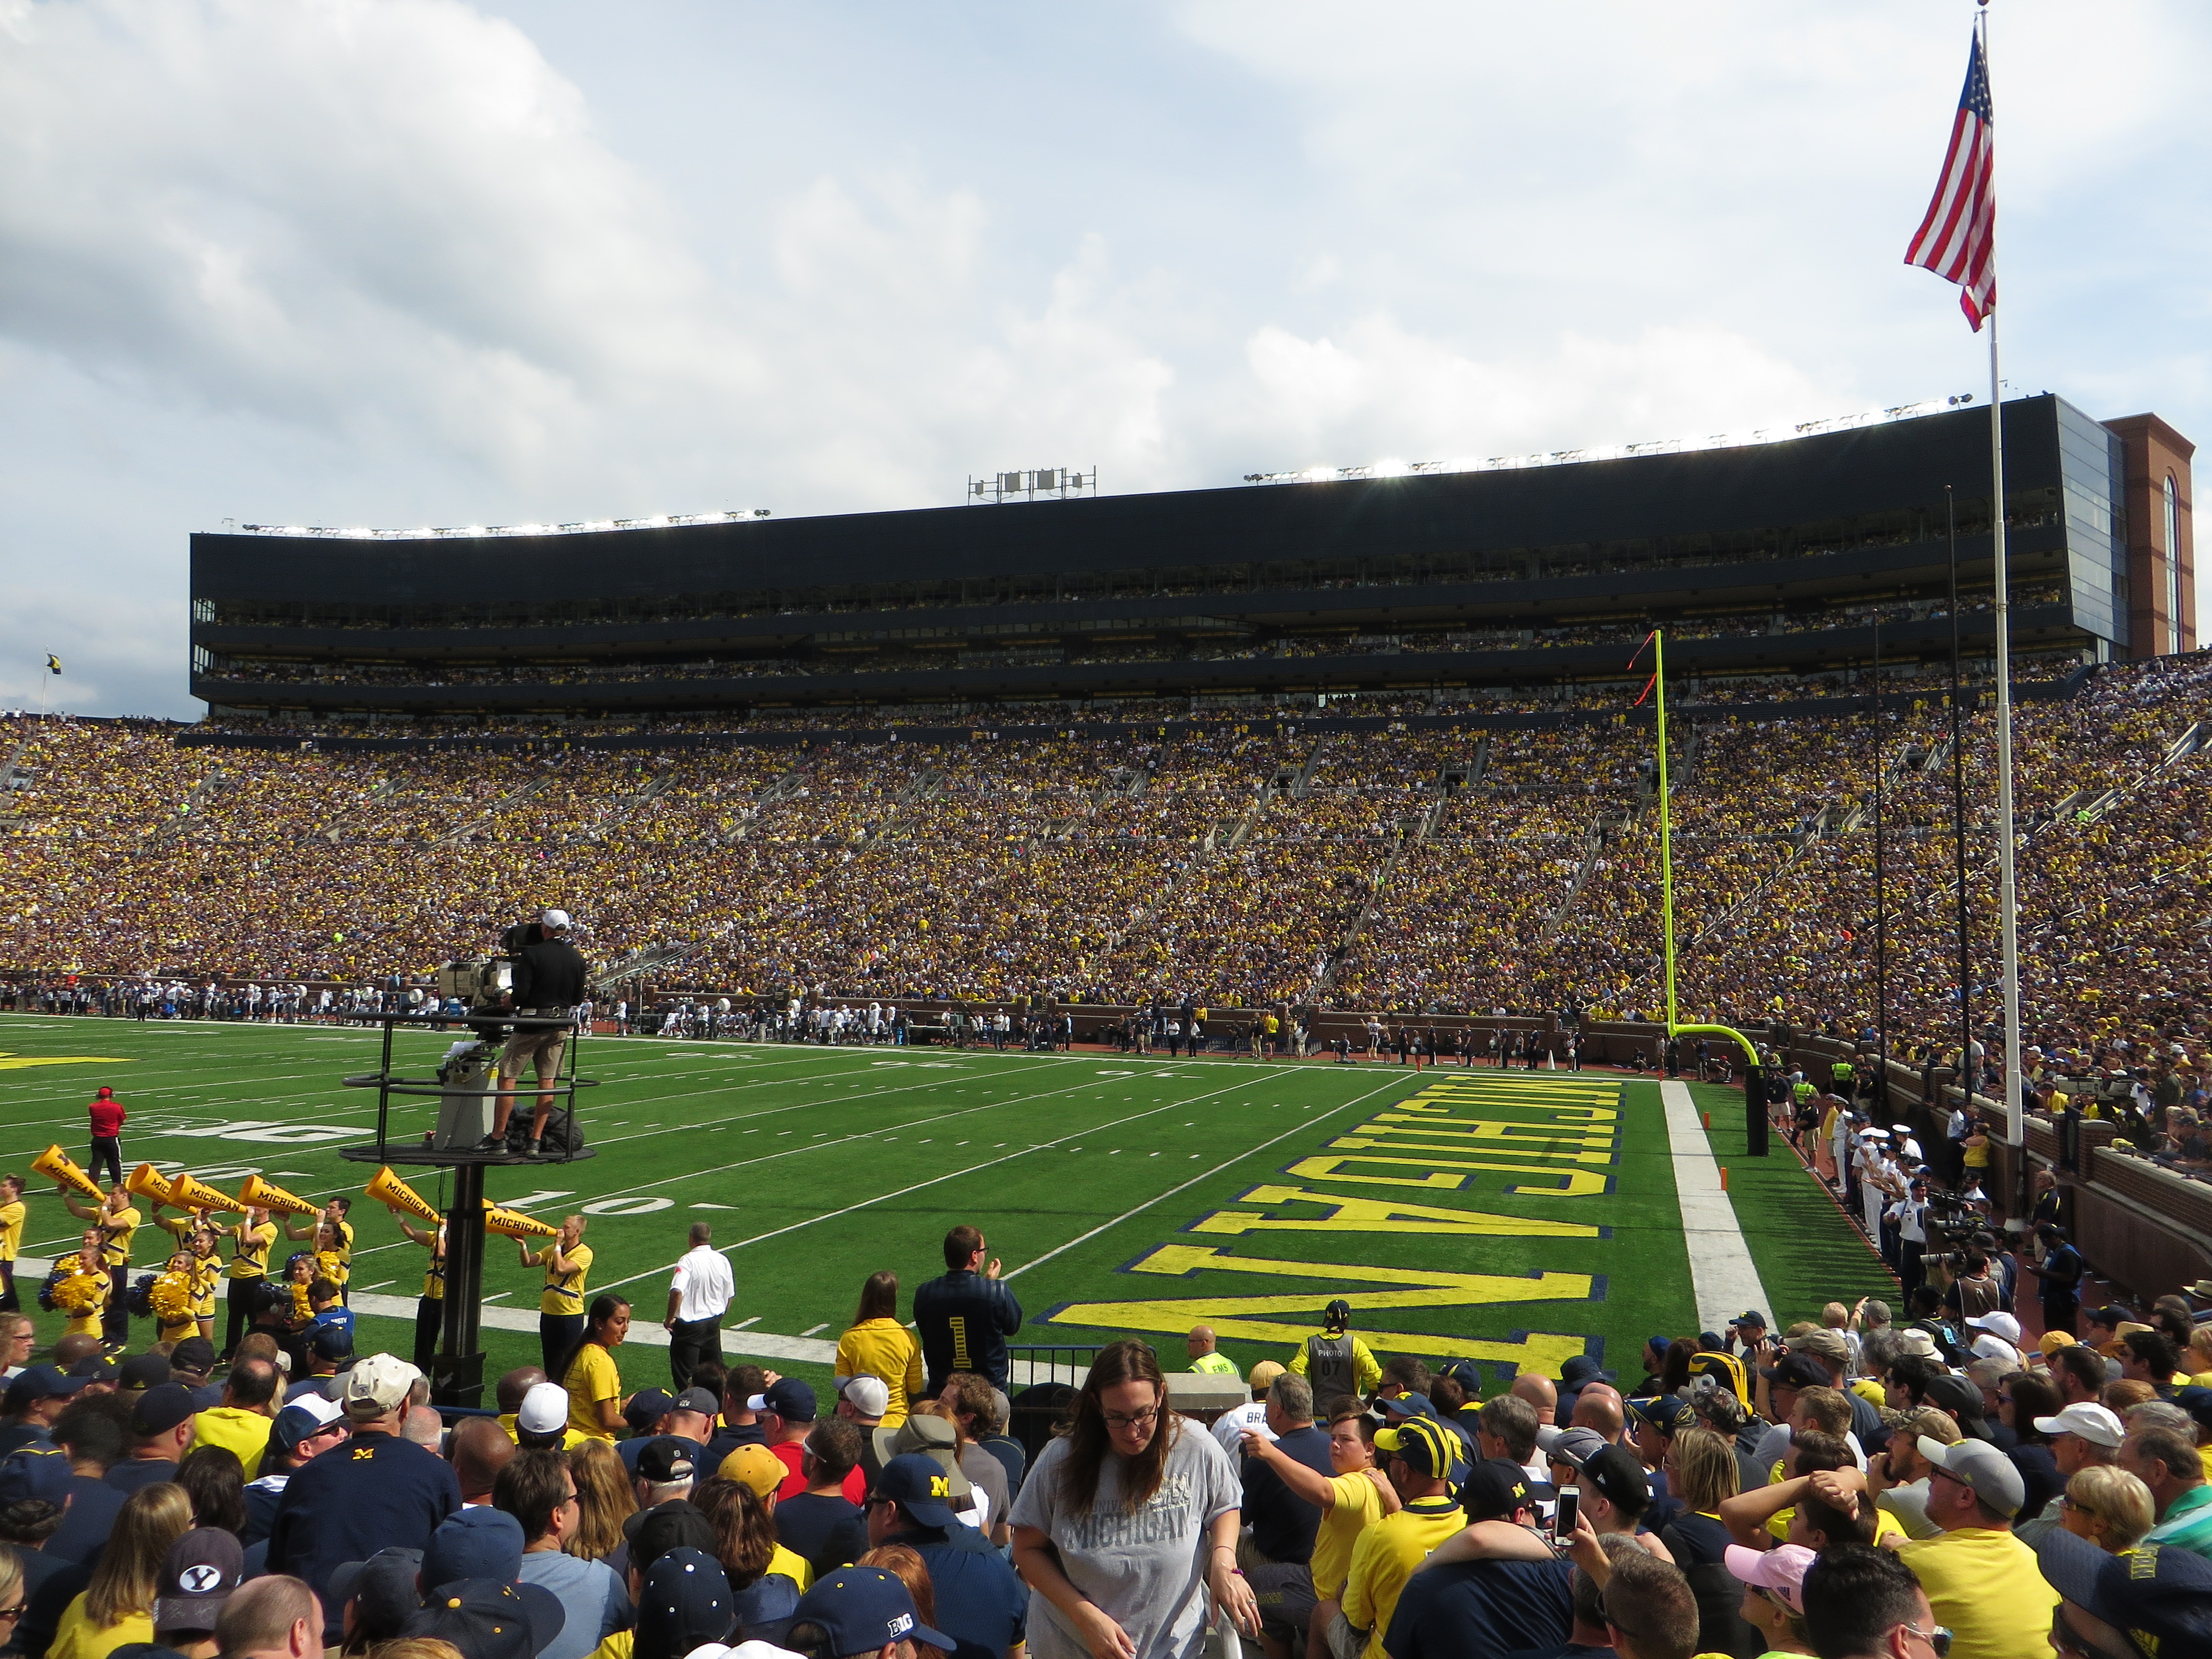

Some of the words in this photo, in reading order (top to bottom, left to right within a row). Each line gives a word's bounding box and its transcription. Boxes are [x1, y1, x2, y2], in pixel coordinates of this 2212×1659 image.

[45, 1163, 97, 1197] MICHIGAN
[189, 1187, 240, 1212] MICHIGAN
[257, 1190, 313, 1215] MICHIGAN
[385, 1181, 435, 1220] MICHIGAN
[496, 1190, 675, 1215] 10
[489, 1214, 549, 1235] MICHIGAN
[1034, 1074, 1626, 1380] MICHIGAN
[949, 1317, 972, 1368] 1
[1212, 1363, 1229, 1374] EMS
[1322, 1361, 1340, 1376] 07
[352, 1448, 375, 1460] M
[930, 1475, 949, 1498] M
[1511, 1481, 1526, 1499] M
[1064, 1508, 1190, 1550] MICHIGAN
[185, 1567, 216, 1590] Y
